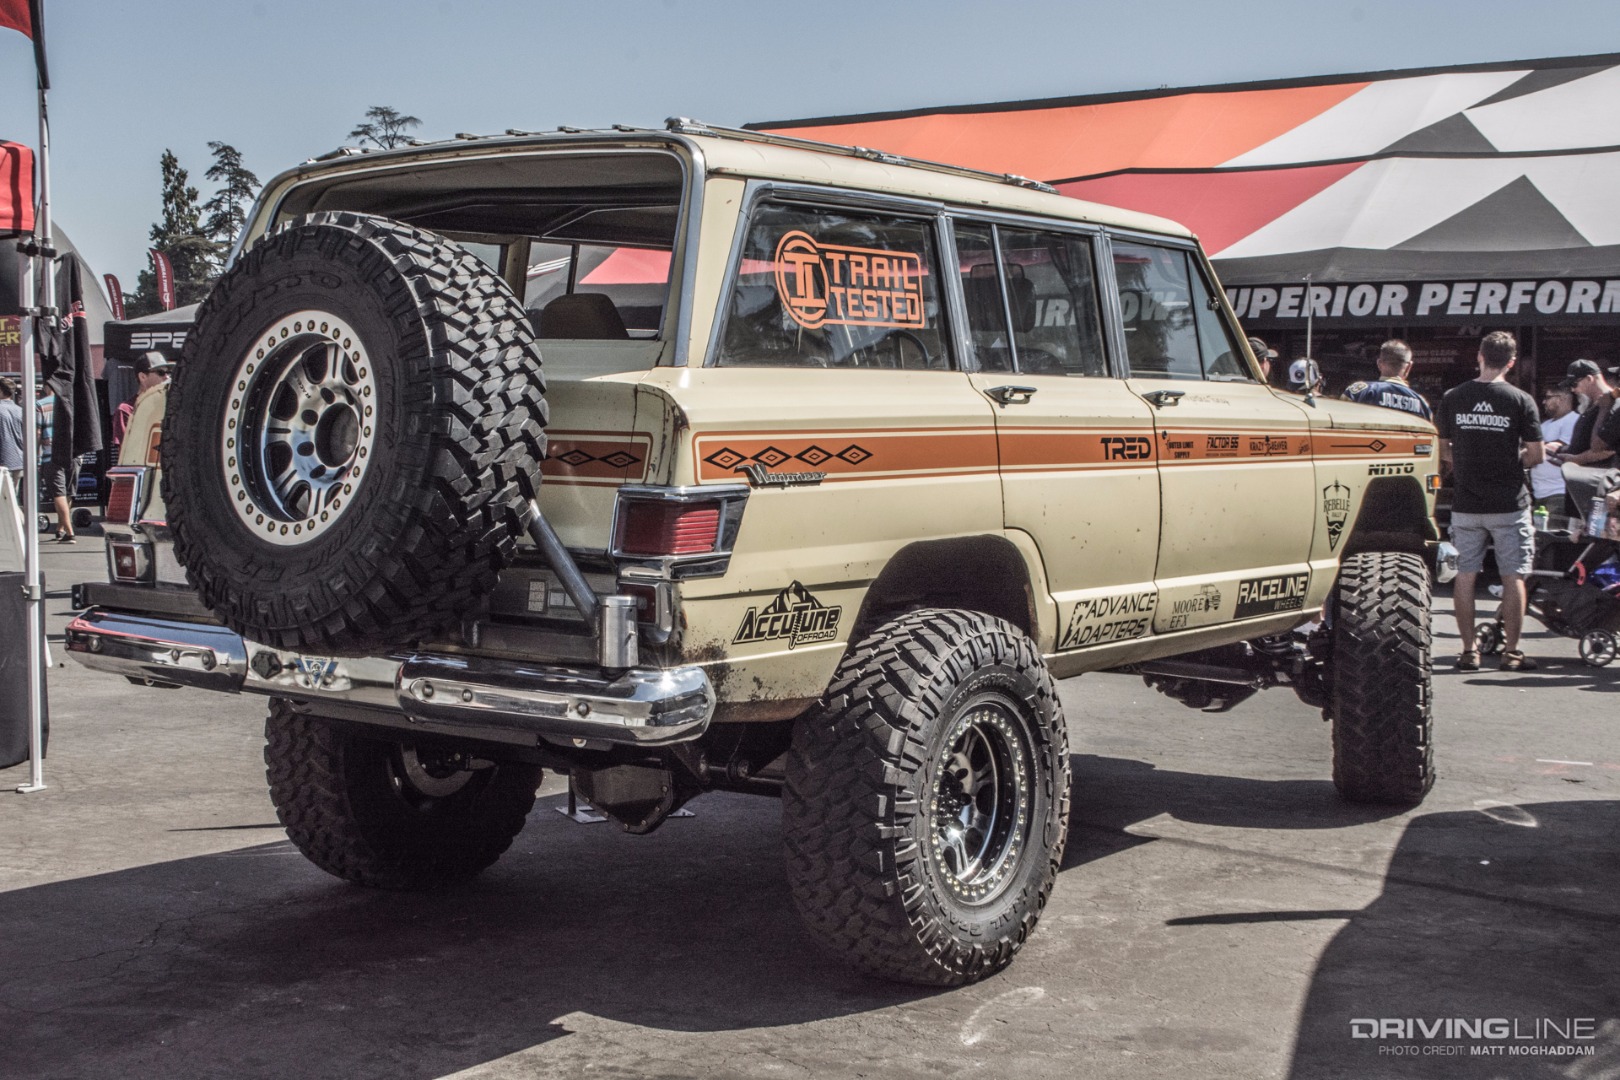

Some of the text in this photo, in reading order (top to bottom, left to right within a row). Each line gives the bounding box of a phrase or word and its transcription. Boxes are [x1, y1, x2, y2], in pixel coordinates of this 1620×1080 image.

[825, 252, 918, 290] TRAIL
[829, 286, 920, 321] TESTED
[1378, 391, 1421, 414] JACKSON
[1455, 413, 1511, 428] BACKWOODS
[1100, 437, 1152, 460] TRED
[1206, 437, 1230, 449] FACTOR
[1368, 463, 1415, 475] NITTO
[1323, 498, 1350, 516] REBELLE
[1237, 574, 1308, 605] RACELINE
[1085, 592, 1157, 619] ADVANCE
[1172, 598, 1204, 614] MOORE
[1169, 613, 1190, 629] EFX
[797, 629, 836, 642] OFFROAD
[1067, 617, 1149, 647] ADAPTERS
